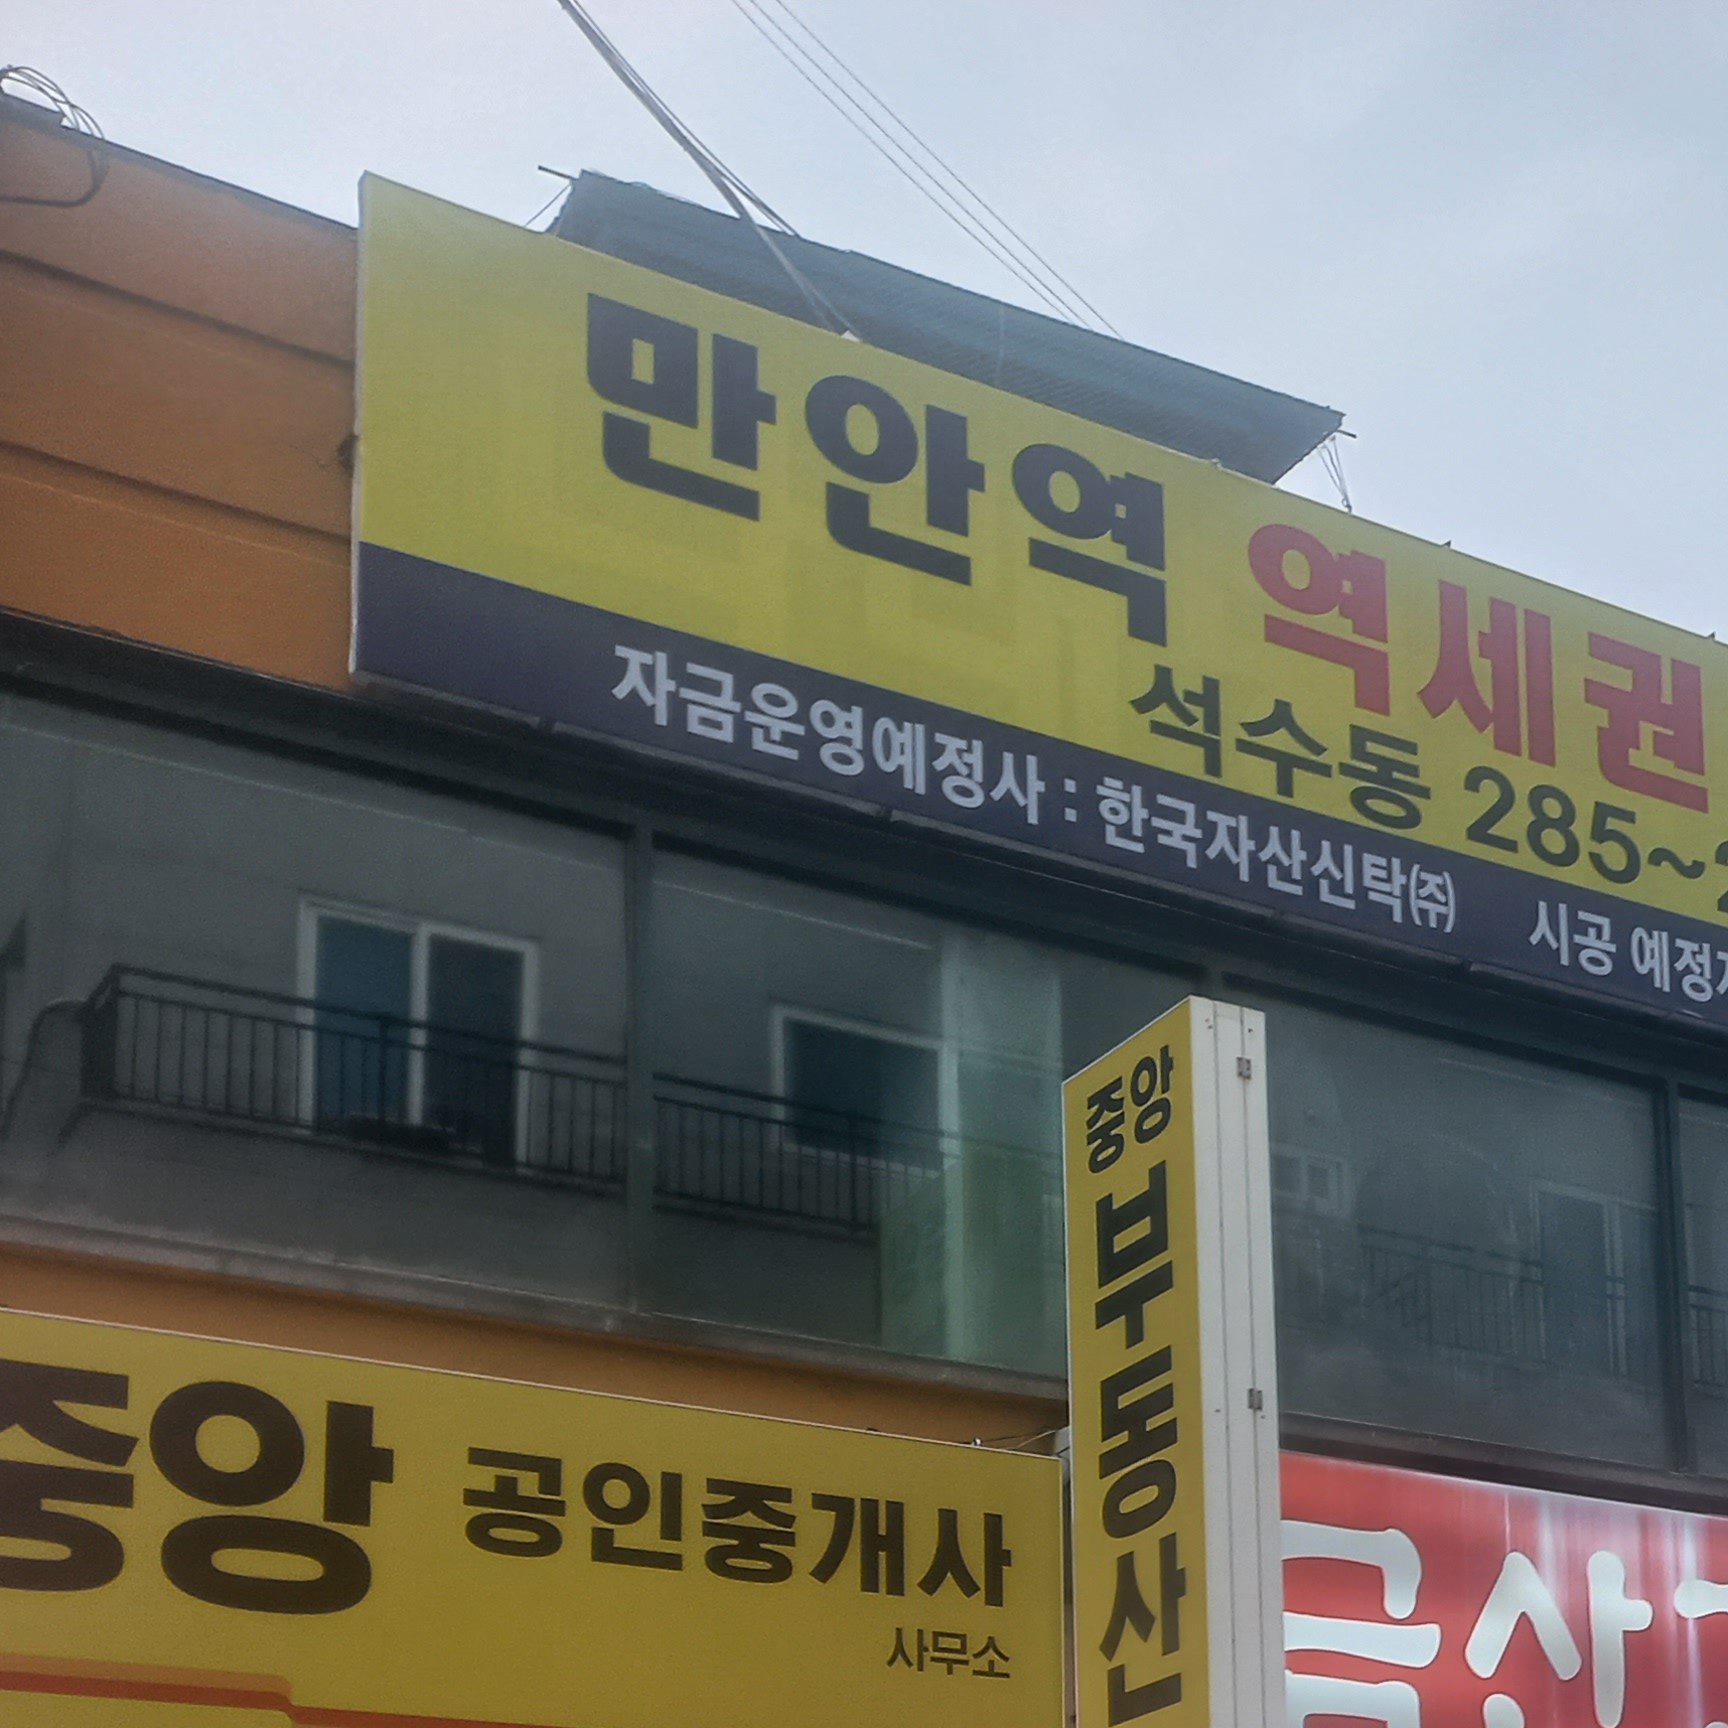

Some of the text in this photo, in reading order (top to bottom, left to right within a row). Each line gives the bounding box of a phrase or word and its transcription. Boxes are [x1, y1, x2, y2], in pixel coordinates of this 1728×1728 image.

[587, 293, 1167, 648] 만안역
[1248, 523, 1708, 813] 역세권
[1130, 663, 1431, 831] 석수동
[1530, 899, 1618, 976] 시공
[1085, 1043, 1174, 1175] 중앙
[0, 1357, 1011, 1615] 중앙 공인중개사
[1094, 1158, 1187, 1728] 부동산
[886, 1628, 1011, 1681] 사무소
